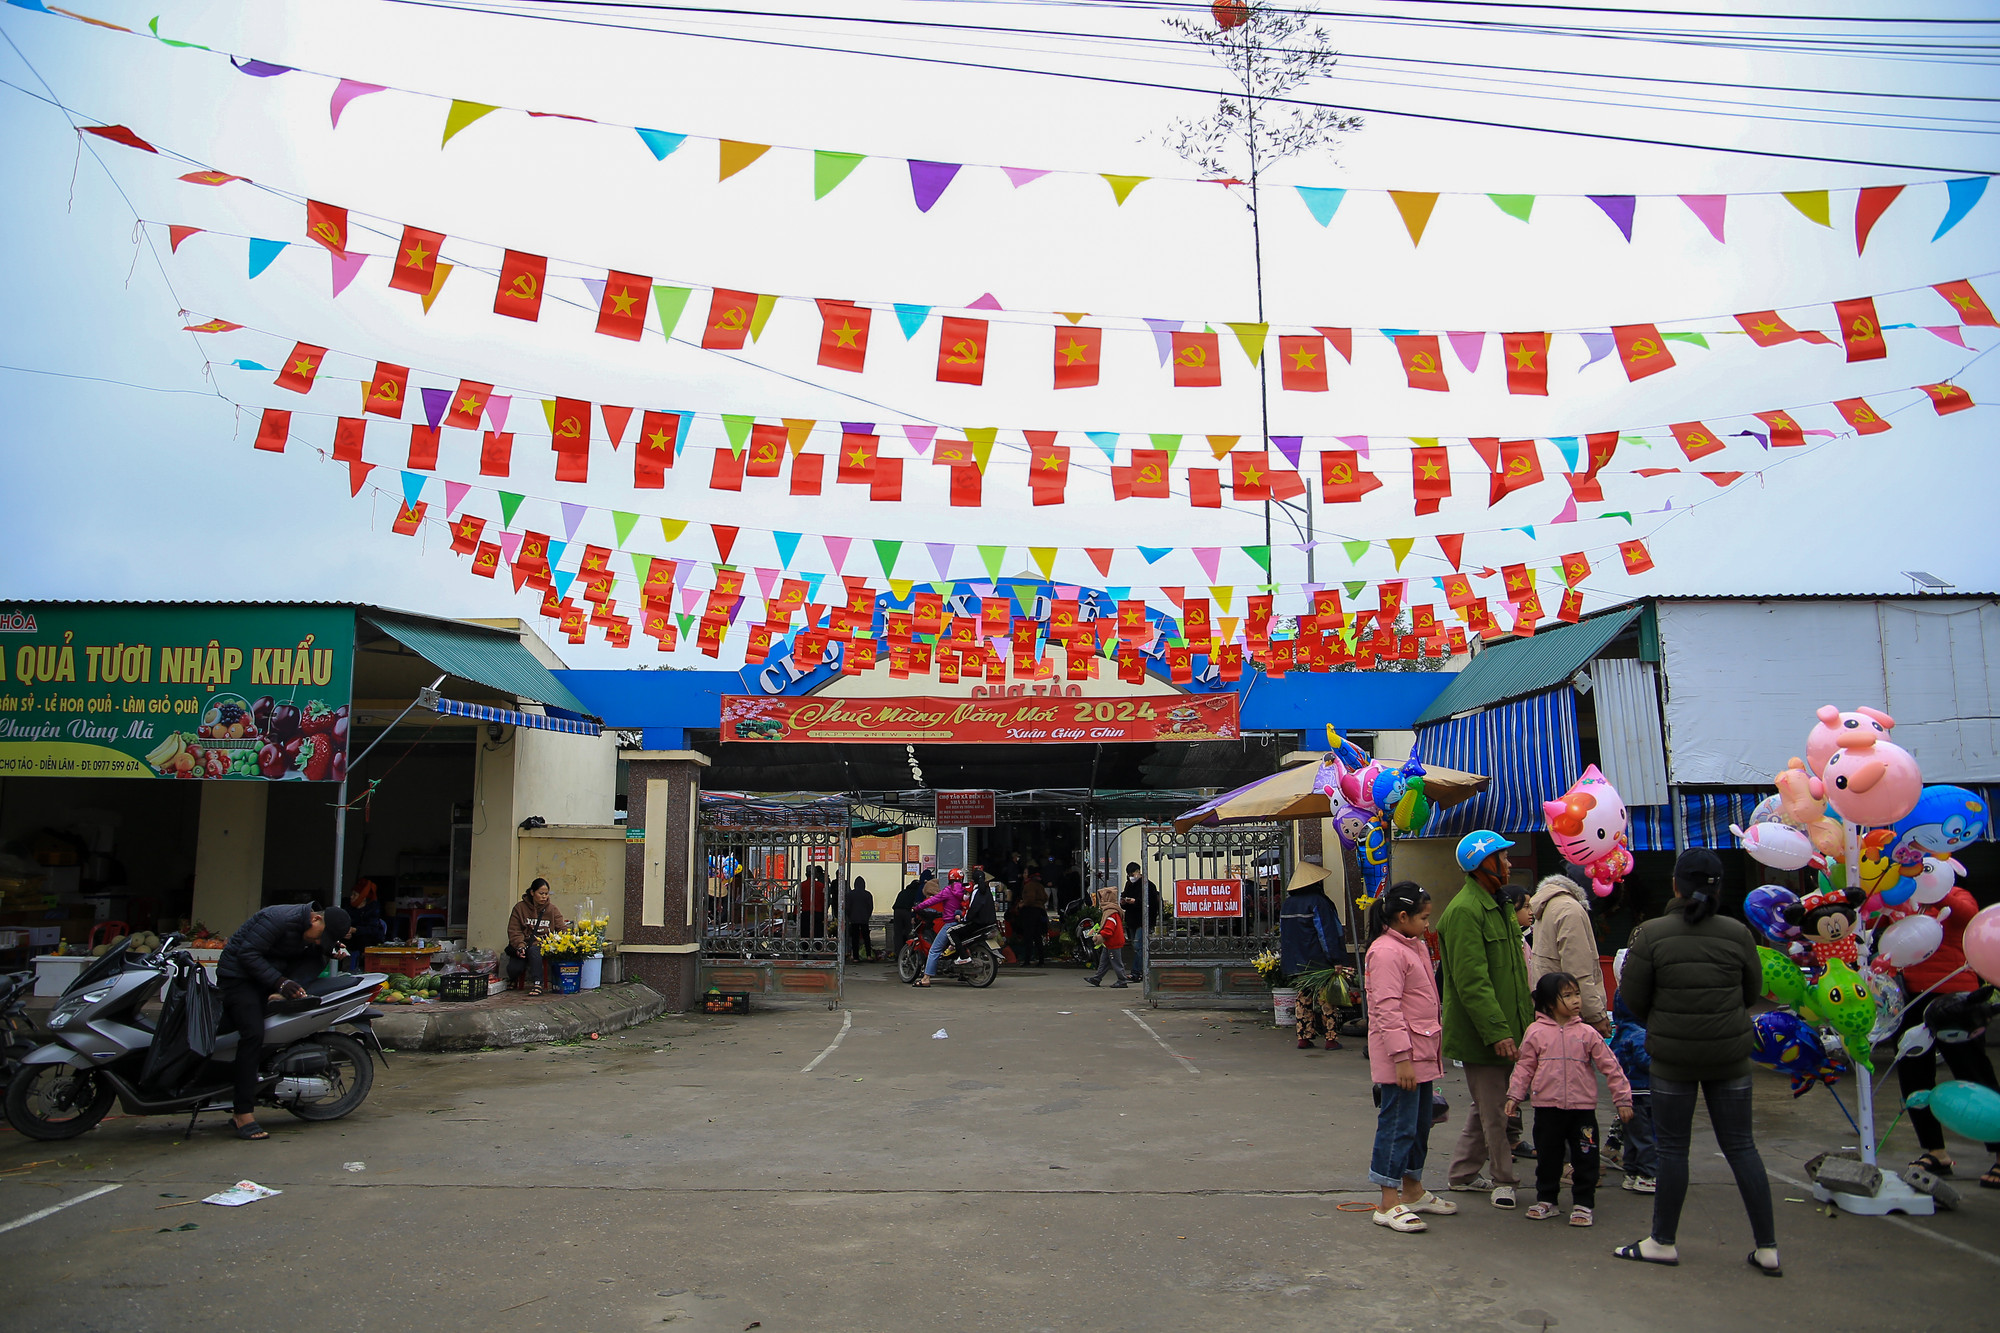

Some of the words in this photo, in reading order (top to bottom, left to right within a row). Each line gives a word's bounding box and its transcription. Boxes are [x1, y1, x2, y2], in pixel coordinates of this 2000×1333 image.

[0, 609, 37, 630] HÒA
[15, 630, 76, 686] QUẢ
[85, 642, 152, 683] TƯƠI
[159, 639, 243, 692] NHẬP
[250, 633, 333, 686] KHẨU
[44, 692, 58, 712] LẺ
[59, 697, 84, 712] HOA
[87, 693, 112, 714] QUẢ
[122, 695, 145, 713] LÀM
[148, 694, 171, 714] GIỎ
[174, 695, 199, 715] QUÀ
[787, 699, 885, 730] Chúc
[873, 704, 946, 729] Mừng
[942, 703, 1009, 728] Năm
[1008, 703, 1061, 723] Mới
[1073, 701, 1158, 722] 2024
[0, 718, 61, 742] Chuyên
[66, 718, 119, 743] Vàng
[122, 719, 155, 740] Mã
[1006, 727, 1047, 739] Xuân
[1051, 726, 1086, 740] Giáp
[1089, 726, 1126, 738] Thìn
[93, 760, 110, 771] 0977
[111, 760, 125, 771] 599
[126, 760, 140, 771] 674
[1186, 882, 1209, 896] CẢNH
[1211, 882, 1231, 896] GIÁC
[1179, 900, 1198, 914] TRỘM
[1198, 898, 1212, 911] CẤP
[1213, 899, 1224, 911] TÀI
[1224, 898, 1238, 911] SẢN
